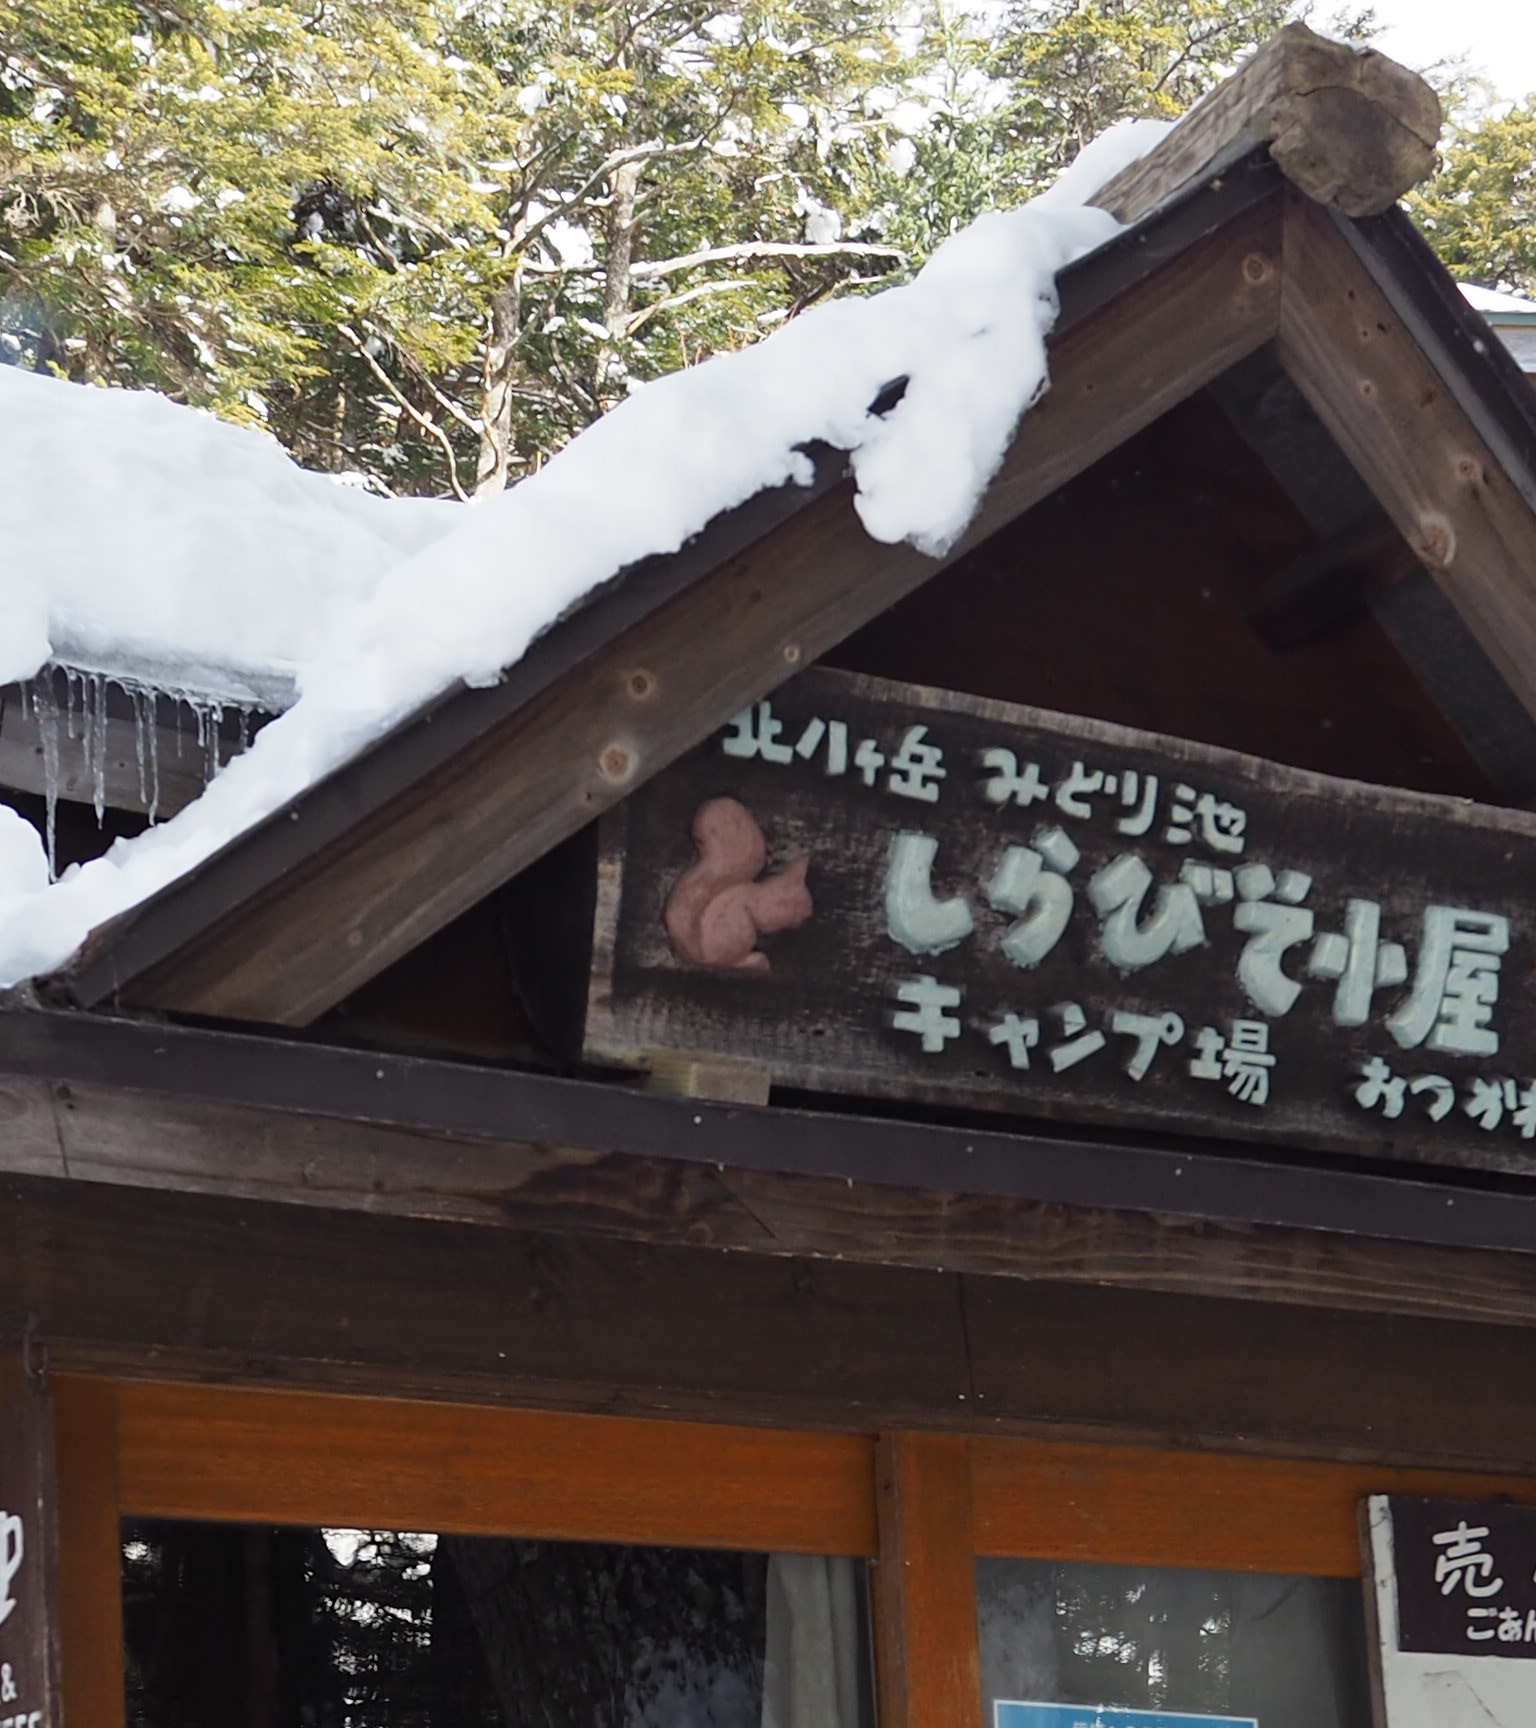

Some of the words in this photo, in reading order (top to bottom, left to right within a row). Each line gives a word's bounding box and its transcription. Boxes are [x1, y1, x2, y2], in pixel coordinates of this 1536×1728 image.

[982, 748, 1247, 854] みどり池
[885, 828, 1511, 1057] しらびそ小屋
[892, 976, 1276, 1106] キャンプ場
